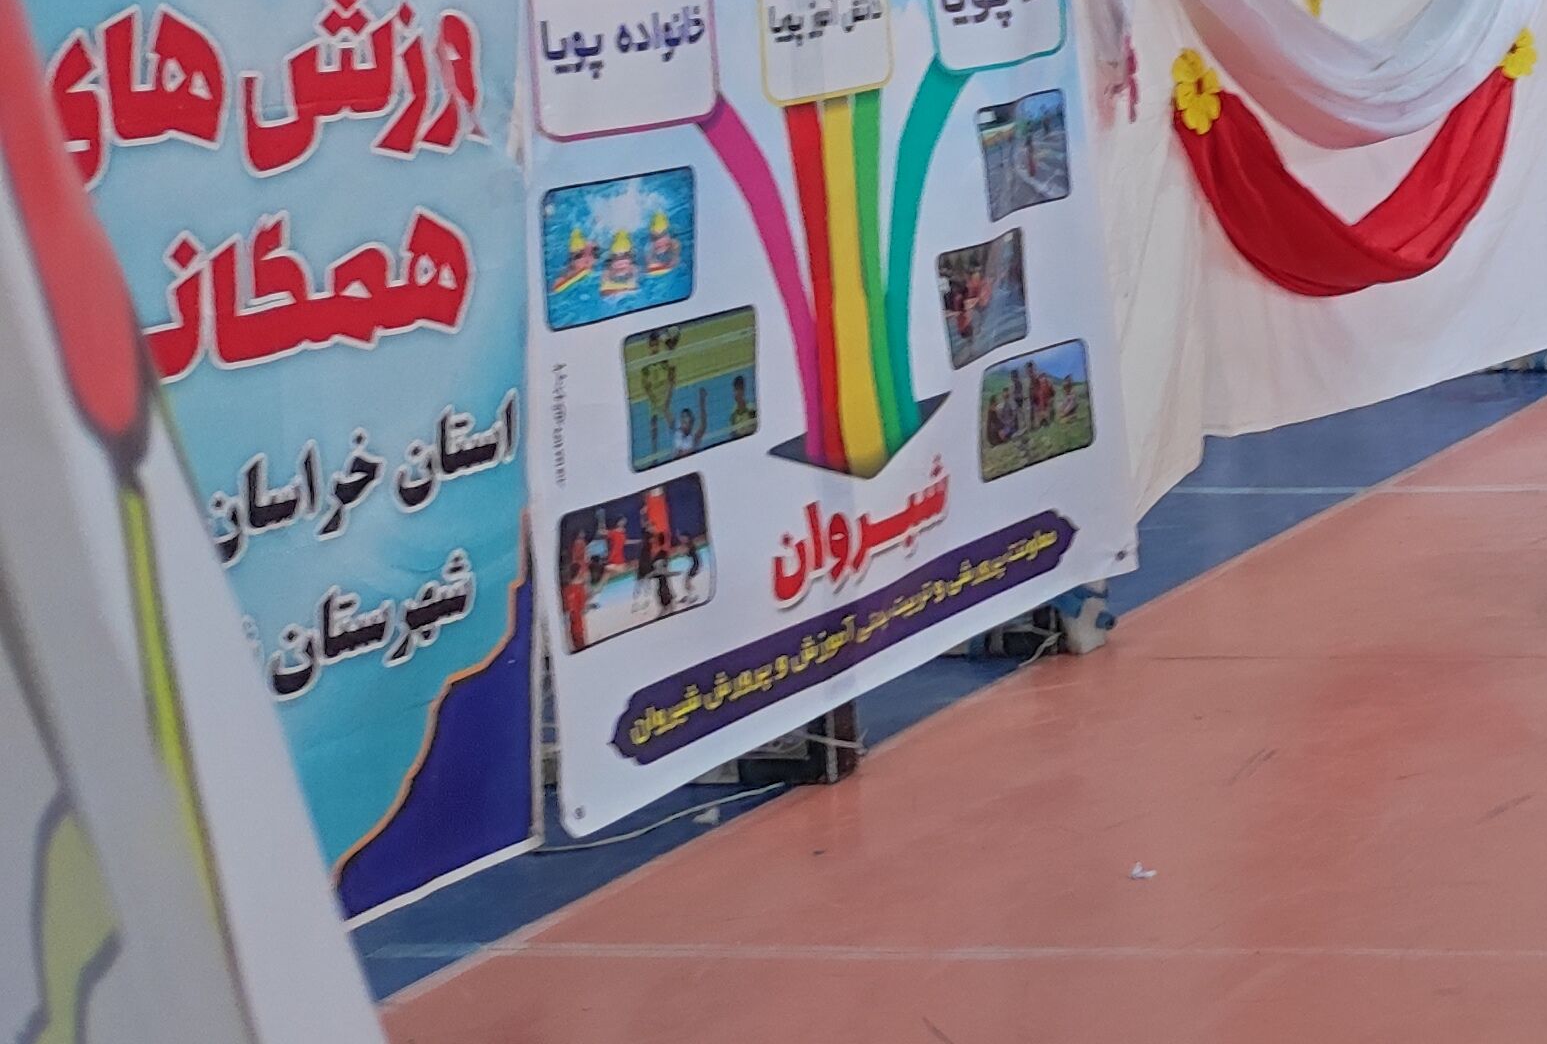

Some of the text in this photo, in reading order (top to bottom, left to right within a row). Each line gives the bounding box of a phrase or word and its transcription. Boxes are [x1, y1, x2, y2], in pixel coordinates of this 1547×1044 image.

[49, 3, 226, 192] های
[539, 4, 706, 79] خانواده پویا
[767, 6, 808, 47] پویا
[143, 206, 475, 386] همگان
[208, 426, 387, 569] خراسان
[393, 387, 520, 513] استان
[772, 454, 950, 606] شیروان
[268, 548, 476, 702] شهرستان
